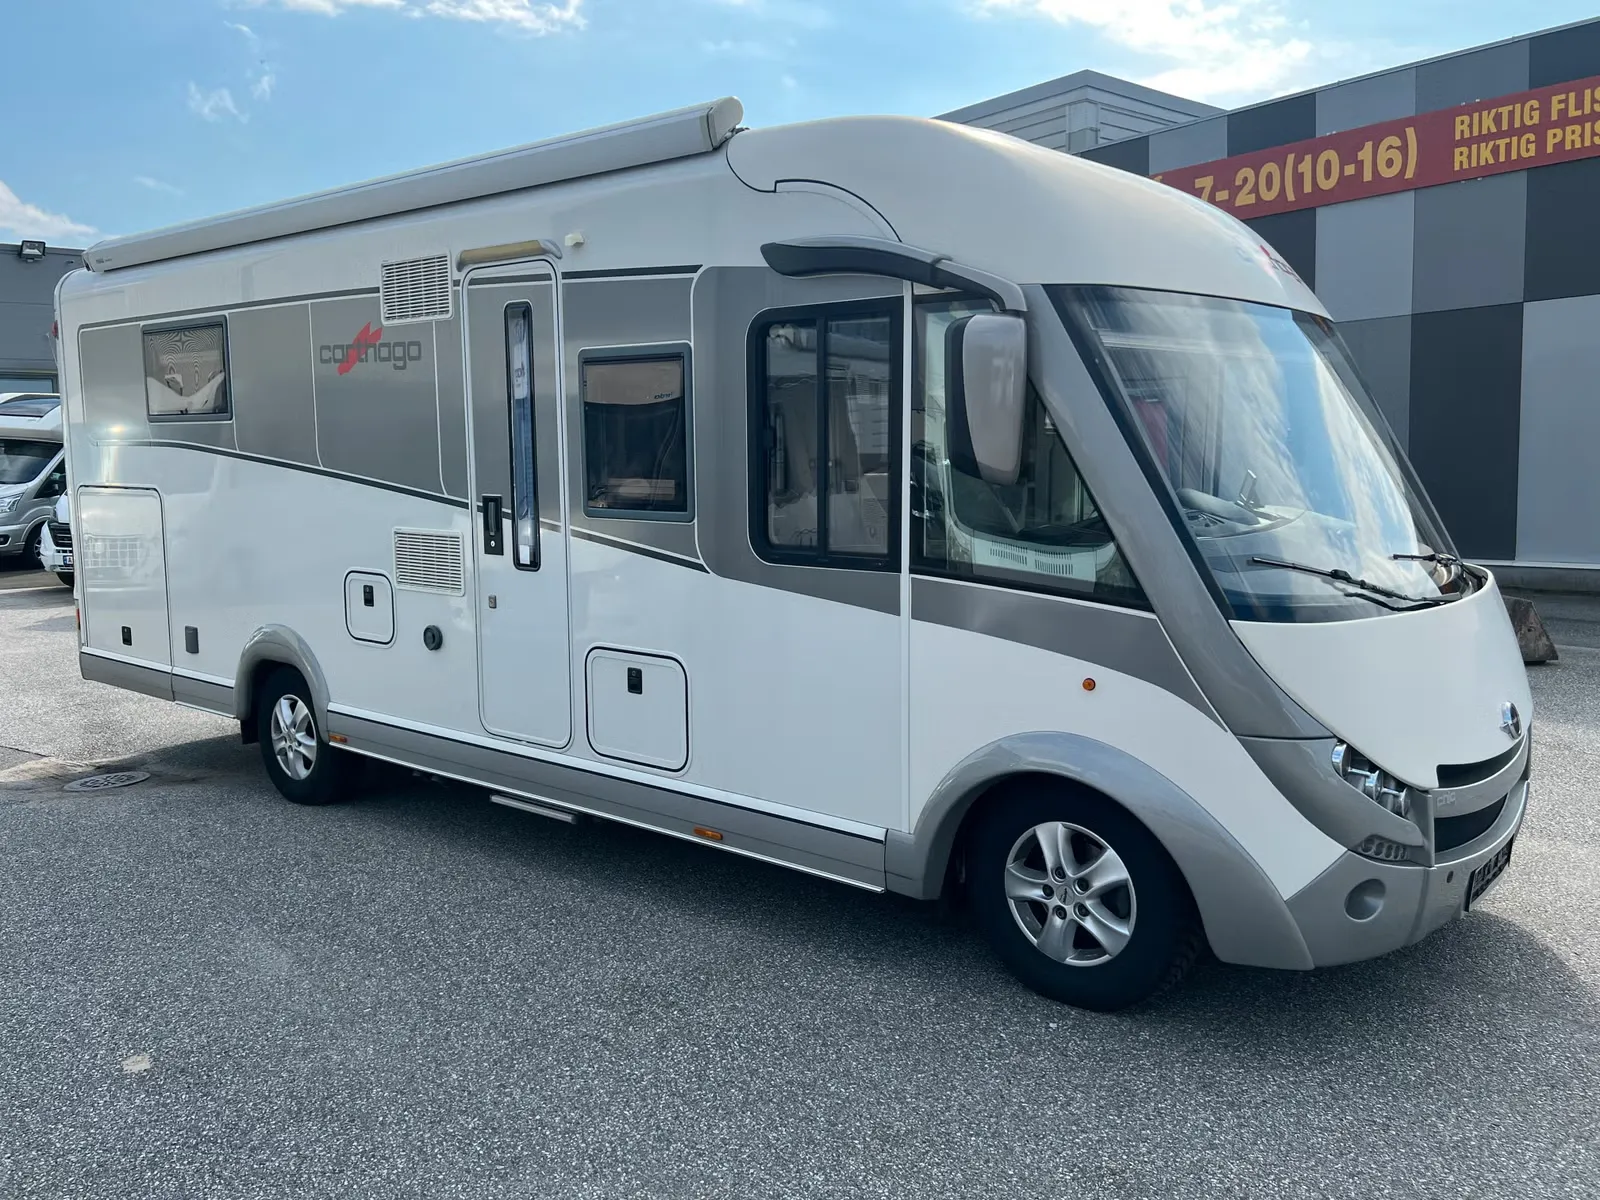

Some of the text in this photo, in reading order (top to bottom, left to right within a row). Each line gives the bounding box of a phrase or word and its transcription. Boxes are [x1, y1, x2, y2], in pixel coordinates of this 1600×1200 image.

[1455, 100, 1540, 140] RIKTIG
[1454, 133, 1536, 171] RIKTIG
[320, 338, 421, 370] carthago
